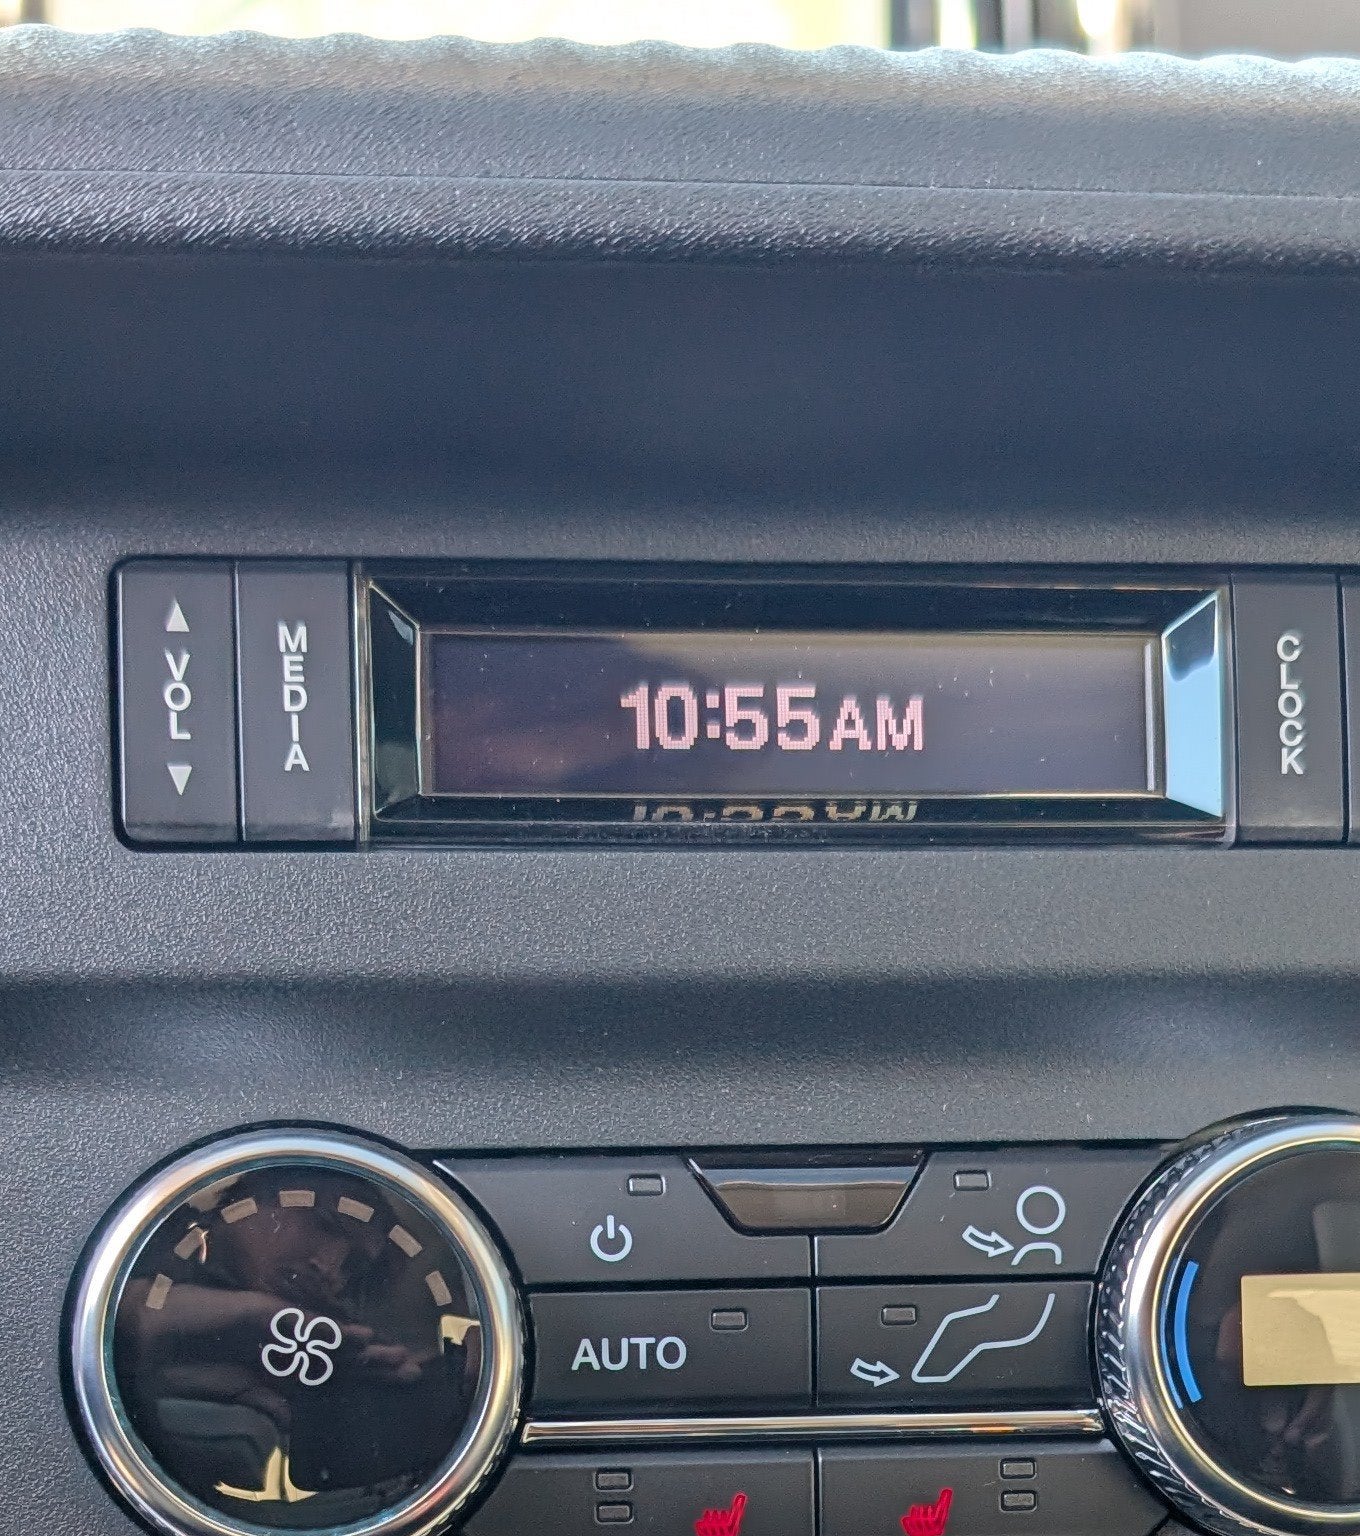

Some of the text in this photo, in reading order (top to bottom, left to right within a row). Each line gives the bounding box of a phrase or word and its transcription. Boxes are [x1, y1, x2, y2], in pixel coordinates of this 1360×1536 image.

[164, 651, 192, 740] VOL
[277, 622, 311, 772] MEDIA
[1277, 634, 1304, 775] CLOCK
[571, 1336, 687, 1371] AUTO
